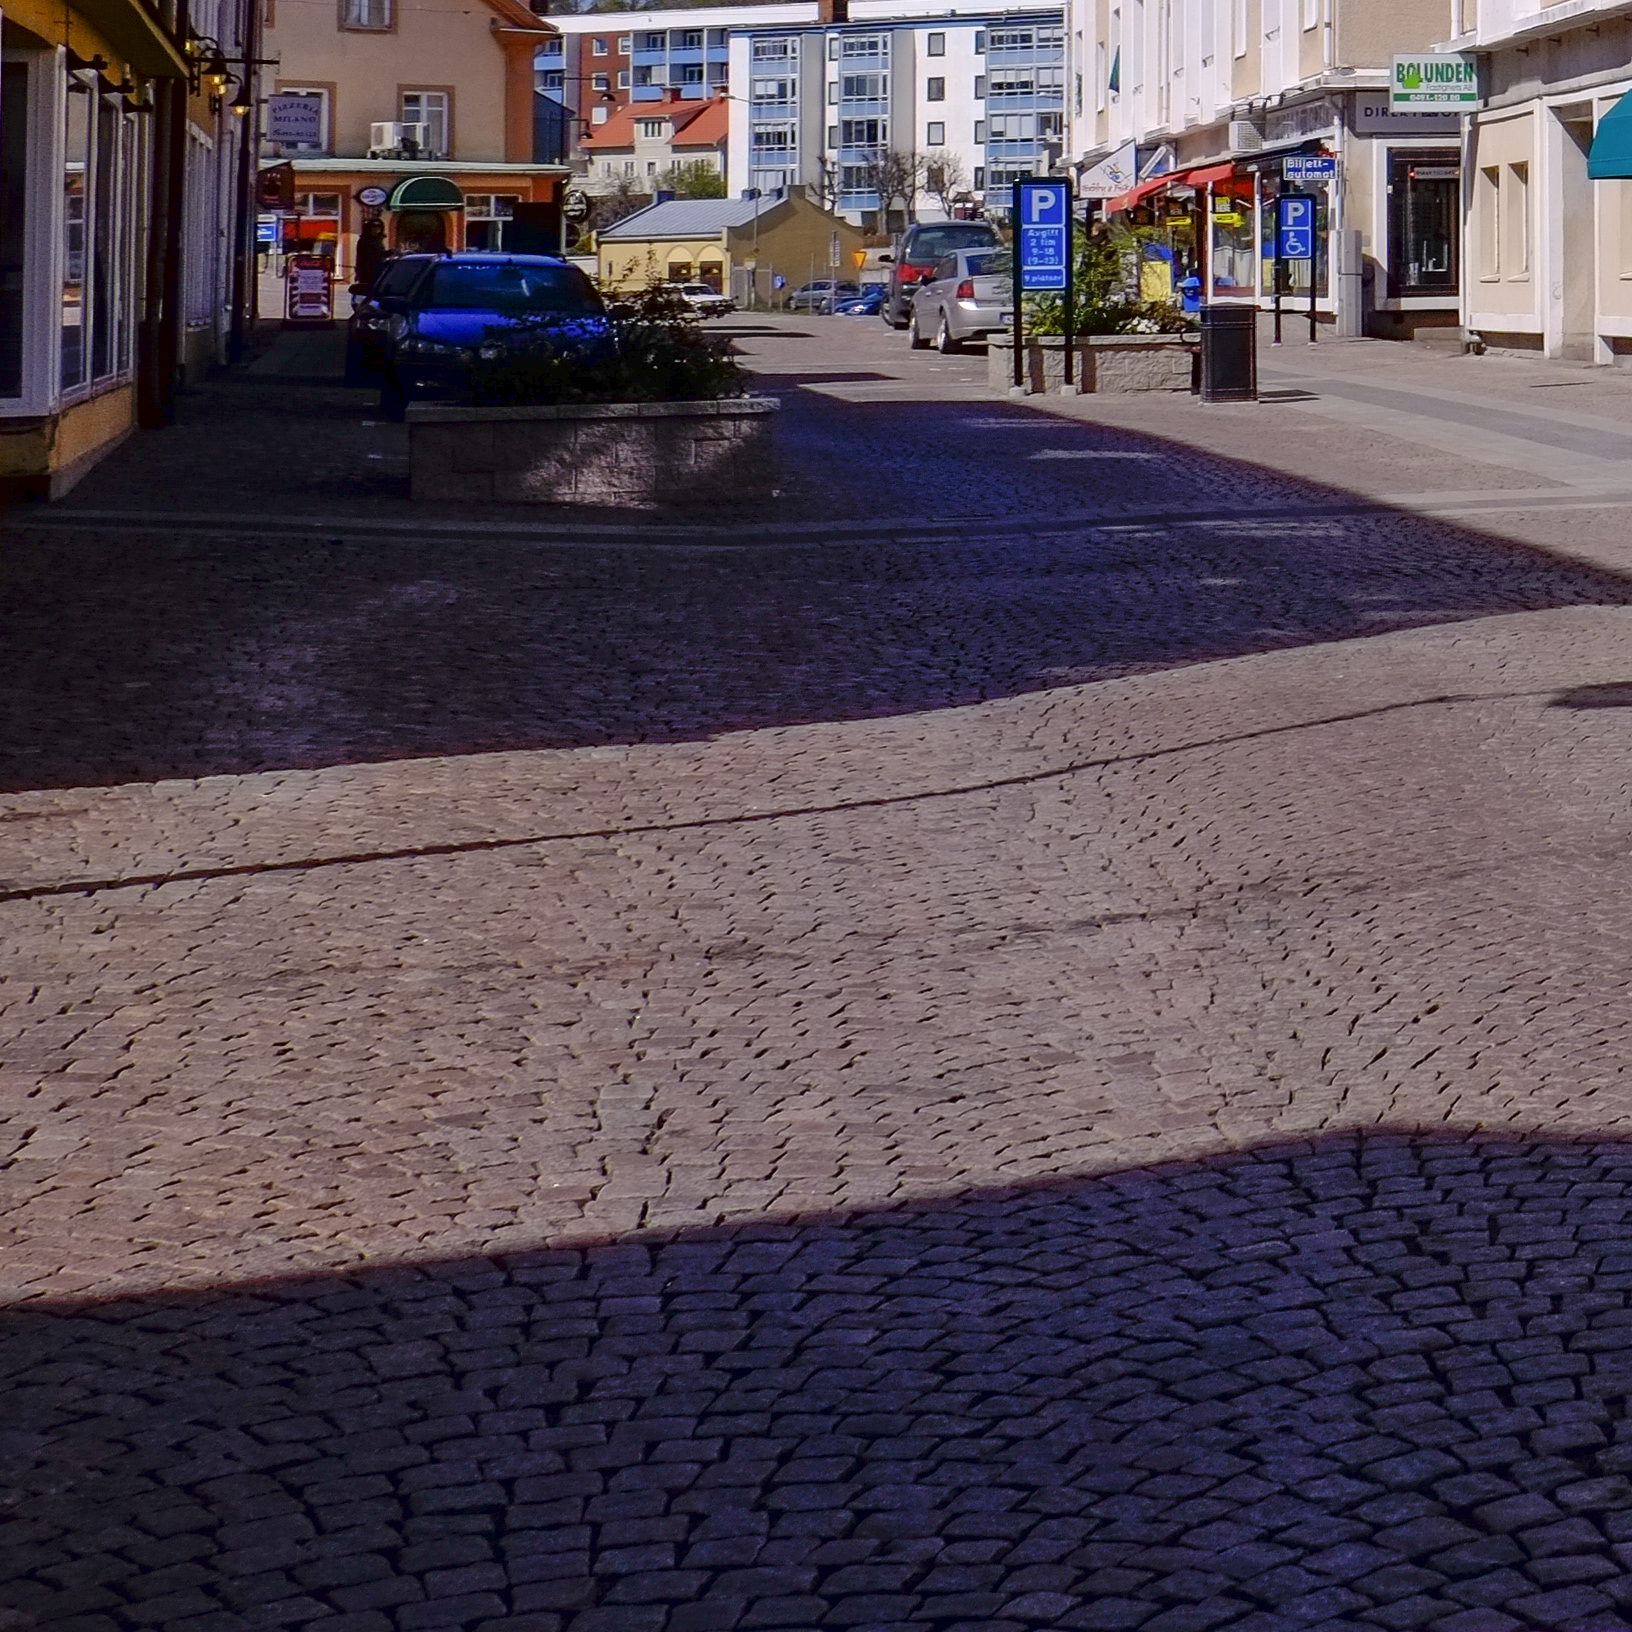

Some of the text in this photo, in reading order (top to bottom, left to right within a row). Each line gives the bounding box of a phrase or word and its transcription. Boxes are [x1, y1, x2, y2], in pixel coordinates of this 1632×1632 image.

[1396, 62, 1474, 84] BOLUNDEN
[271, 102, 320, 116] PIZZERIA
[273, 115, 317, 124] MILANO
[1287, 169, 1335, 179] automat
[1031, 189, 1056, 222] P
[1287, 202, 1305, 226] P
[1028, 229, 1059, 238] Avgift
[1030, 238, 1056, 246] 2 tim
